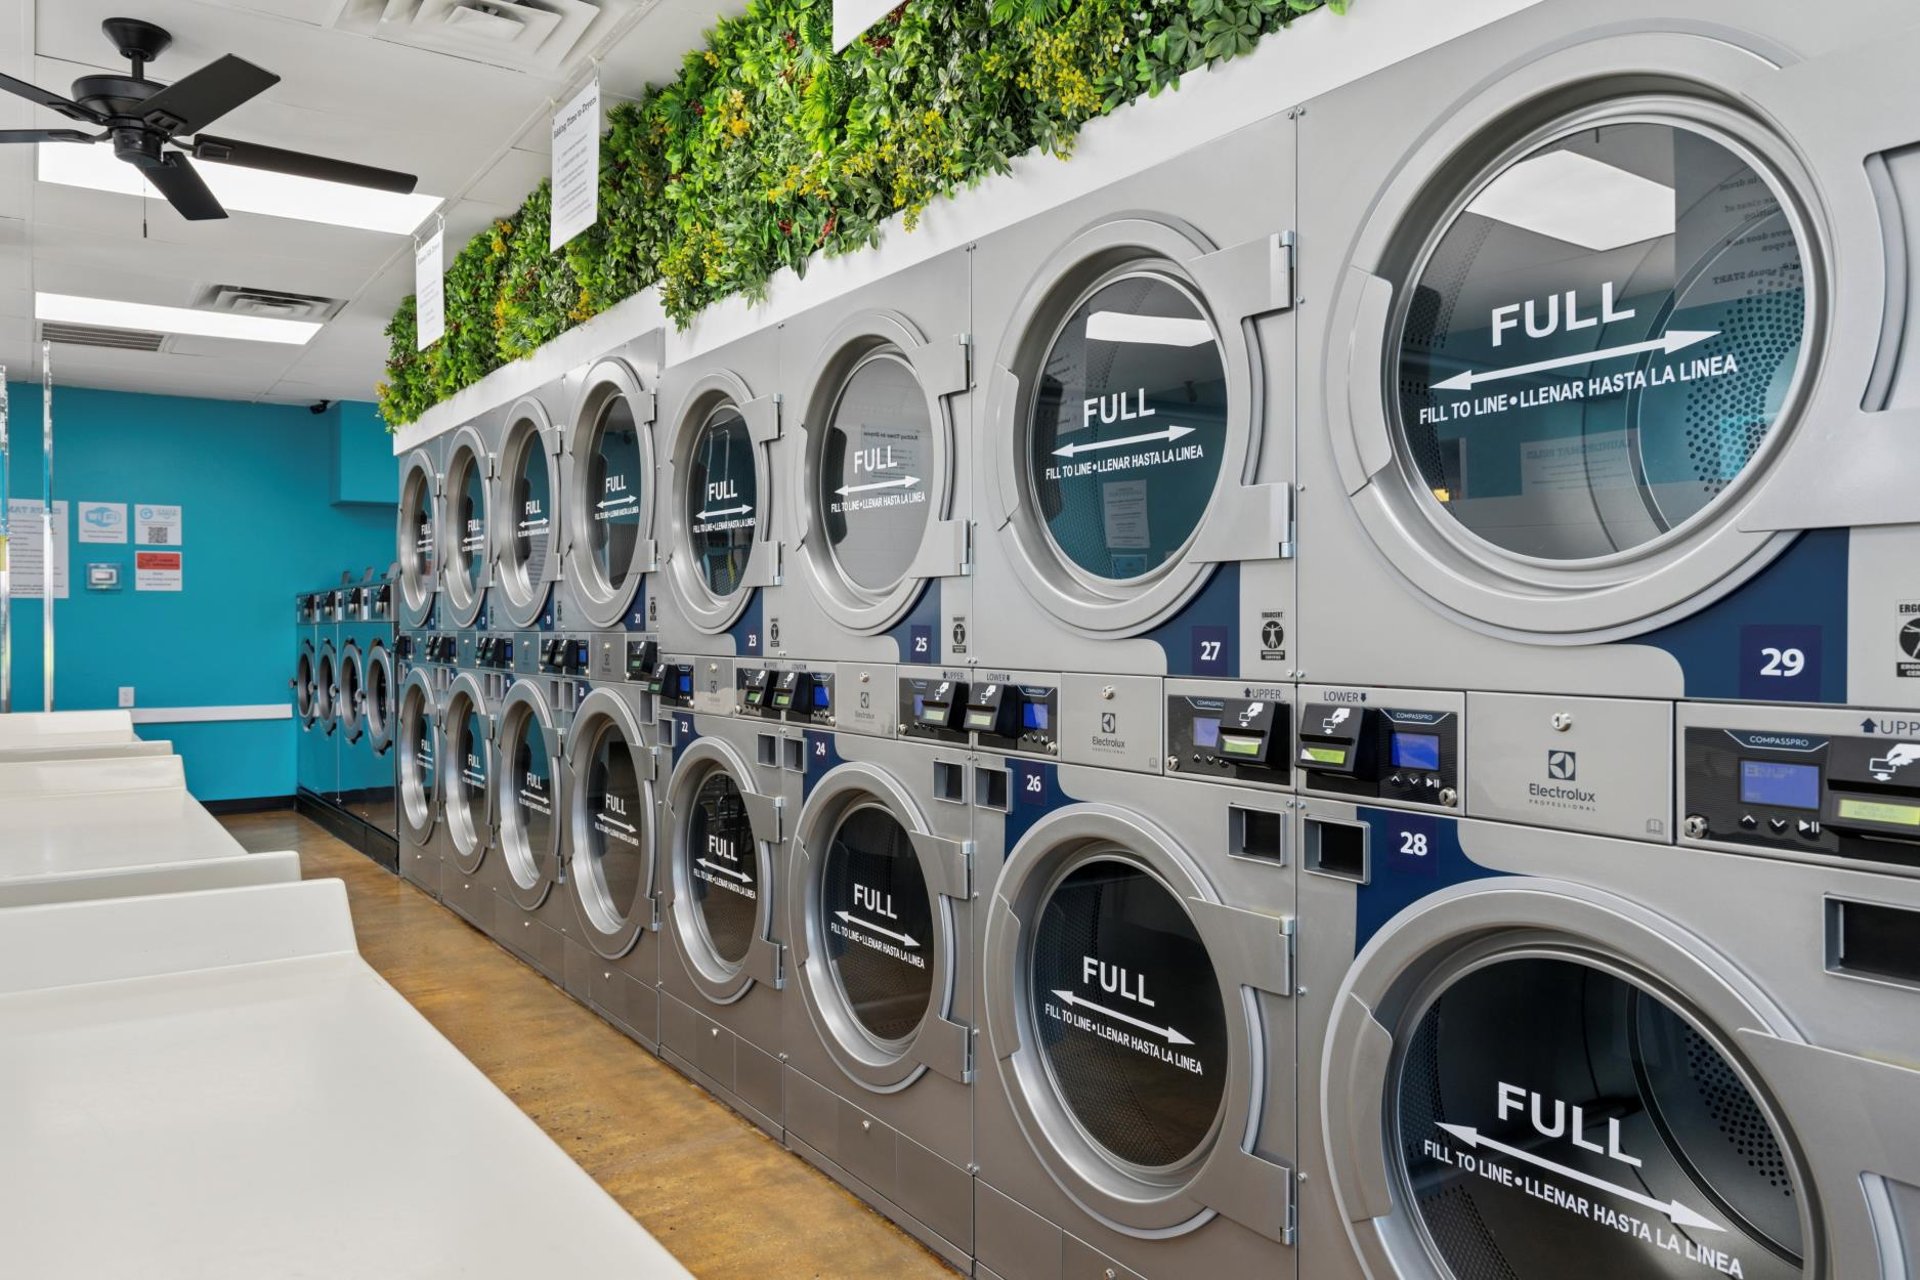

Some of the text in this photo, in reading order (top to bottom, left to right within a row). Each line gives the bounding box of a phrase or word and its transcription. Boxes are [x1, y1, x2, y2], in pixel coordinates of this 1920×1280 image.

[1491, 281, 1635, 347] FULL
[1420, 354, 1738, 424] FILL TO LINE LLENAR HASTA LA LINEA
[1084, 388, 1156, 428] FULL
[854, 445, 898, 474] FULL
[1046, 444, 1203, 480] FILL TO LINE LLENAR HASTA LA LINEA
[606, 474, 626, 493] FULL
[708, 480, 738, 502] FULL
[526, 500, 542, 516] FULL
[830, 492, 926, 513] FILL TO LINE LLENAR HASTA LA LINEA
[468, 518, 480, 532] FULL
[748, 634, 757, 647] 23
[916, 637, 928, 652] 25
[1200, 641, 1221, 661] 27
[1760, 648, 1805, 677] 29
[986, 673, 1006, 681] LOWER
[1252, 689, 1281, 699] UPPER
[1323, 691, 1359, 702] LOWER
[1396, 711, 1432, 721] COMPASSPRO
[682, 721, 689, 733] 22
[816, 742, 826, 756] 24
[1092, 736, 1126, 748] Electrolux
[1750, 736, 1808, 748] COMPASSPRO
[468, 754, 480, 769] FULL
[526, 772, 542, 790] FULL
[1026, 774, 1042, 792] 26
[1528, 782, 1596, 803] Electrolux
[606, 793, 626, 816] FULL
[1528, 799, 1596, 812] PROFESSIONAL
[708, 834, 738, 862] FULL
[1400, 830, 1428, 857] 28
[854, 883, 898, 920] FULL
[830, 922, 925, 970] FILL TO LINE LLENAR HASTA LA LINEA
[1084, 956, 1155, 1008] FULL
[1045, 1003, 1203, 1076] FILL TO LINE LLENAR HASTA LA LINEA
[1498, 1081, 1642, 1168] FULL
[1424, 1139, 1744, 1280] FILL TO LINE LLENAR HASTA LA LINEA
